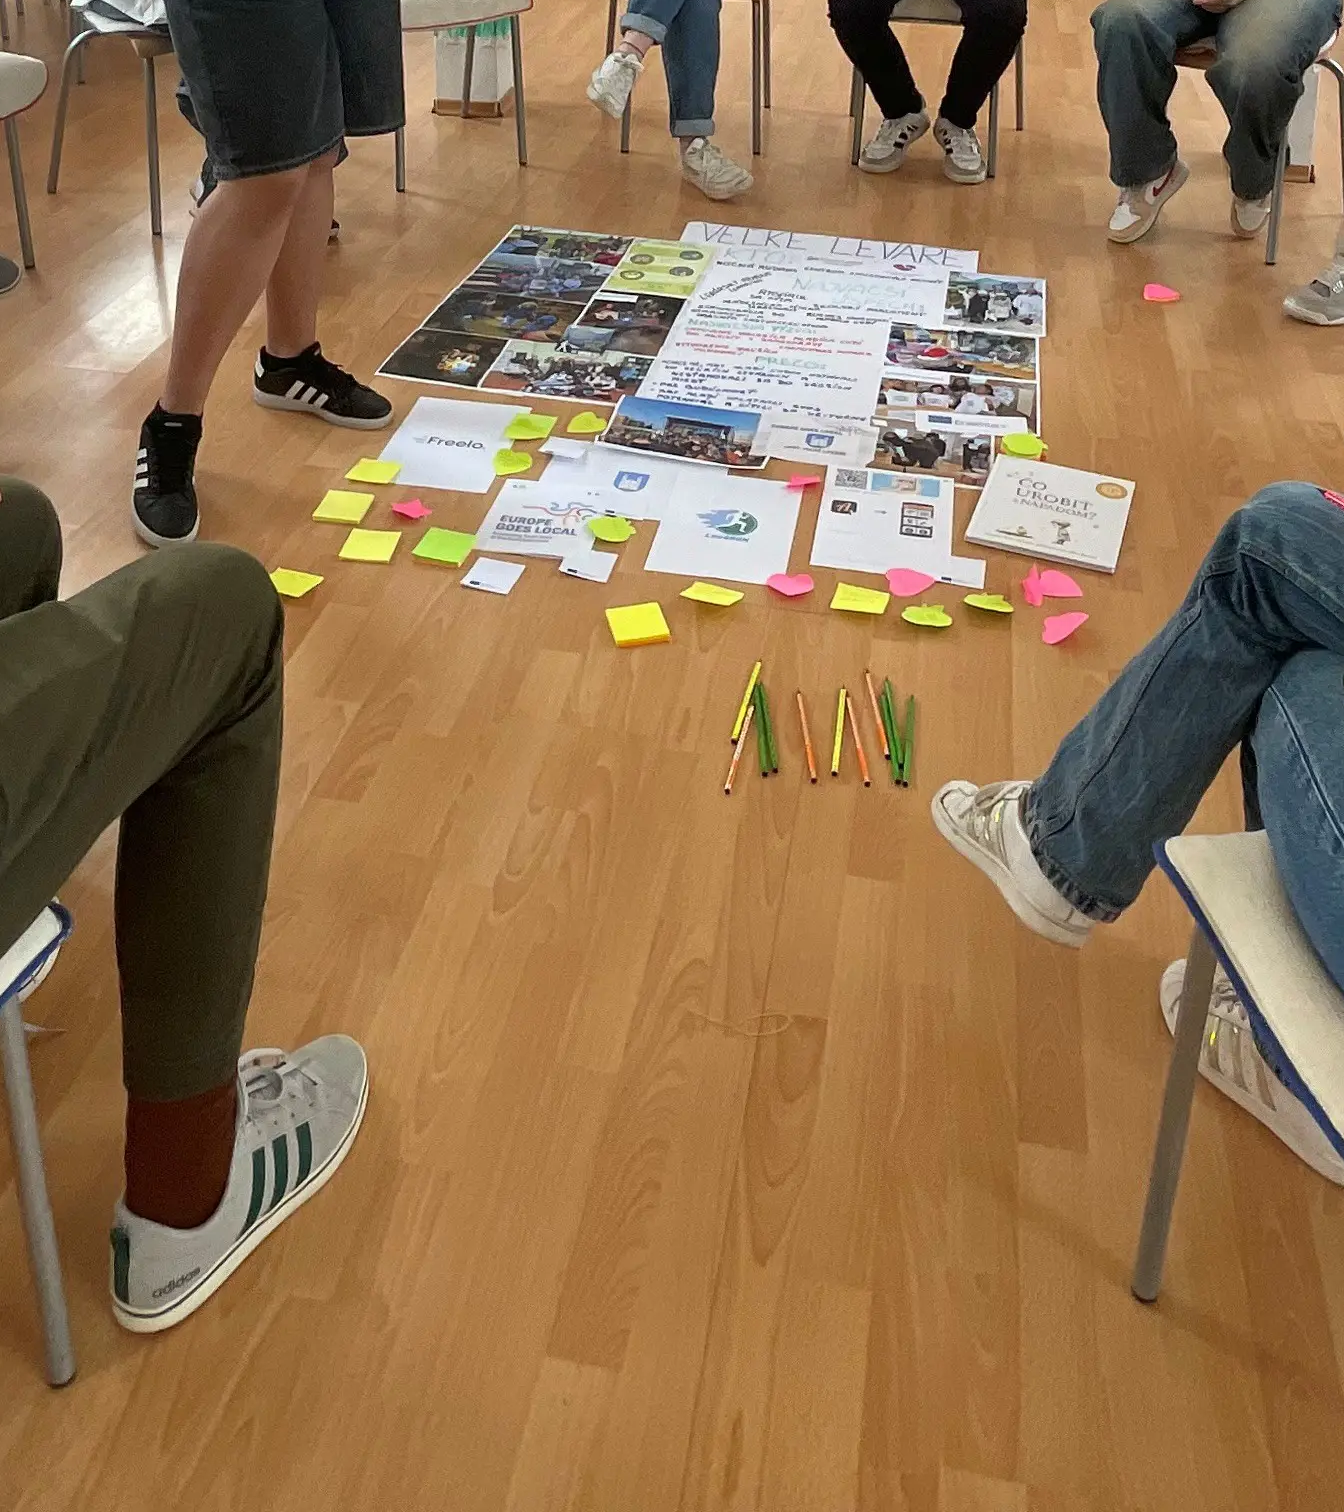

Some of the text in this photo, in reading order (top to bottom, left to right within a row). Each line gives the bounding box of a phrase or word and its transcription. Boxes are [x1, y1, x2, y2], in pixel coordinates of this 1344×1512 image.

[499, 514, 554, 526] EUROPE
[495, 522, 533, 534] GOES
[535, 526, 577, 537] LOCAL
